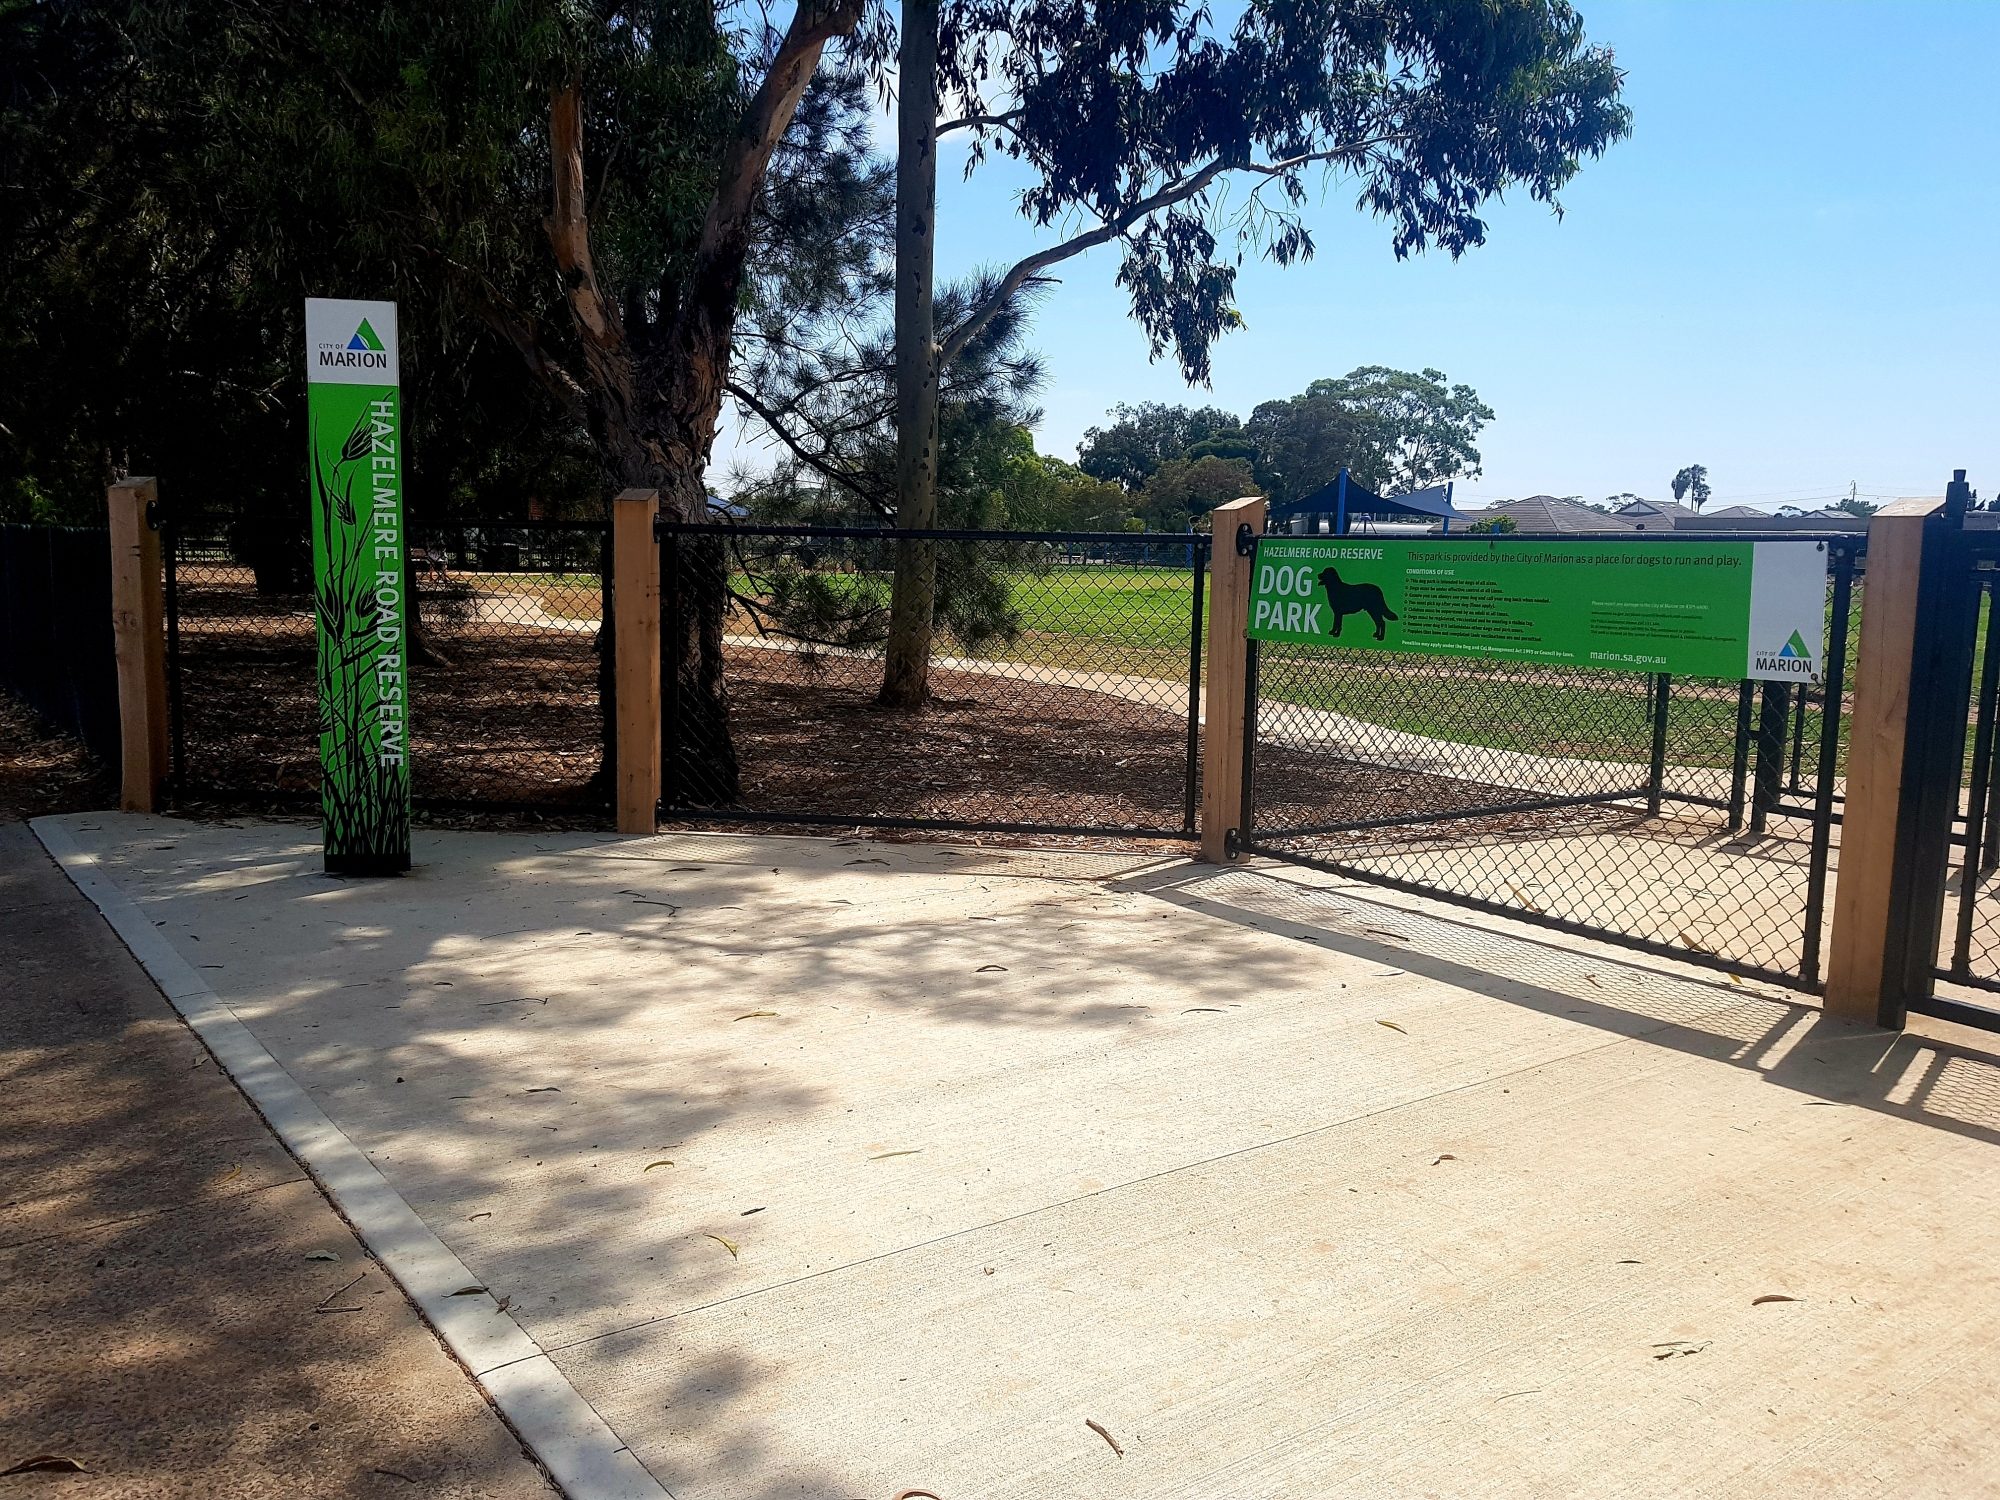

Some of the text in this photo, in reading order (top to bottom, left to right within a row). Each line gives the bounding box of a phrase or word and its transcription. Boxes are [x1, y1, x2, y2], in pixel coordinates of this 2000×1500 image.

[319, 351, 387, 369] MARION
[1263, 547, 1384, 560] HAZELMERE ROAD RESERVE
[1408, 552, 1742, 568] This park is provided by the City of Marion as a place for dogs to run and play.
[370, 400, 404, 767] HAZELMERE ROAD RESERVE
[1258, 565, 1313, 597] DOG
[1254, 600, 1322, 634] PARK
[1590, 651, 1667, 664] marion.sa.gov.au
[1755, 657, 1812, 674] MARION
